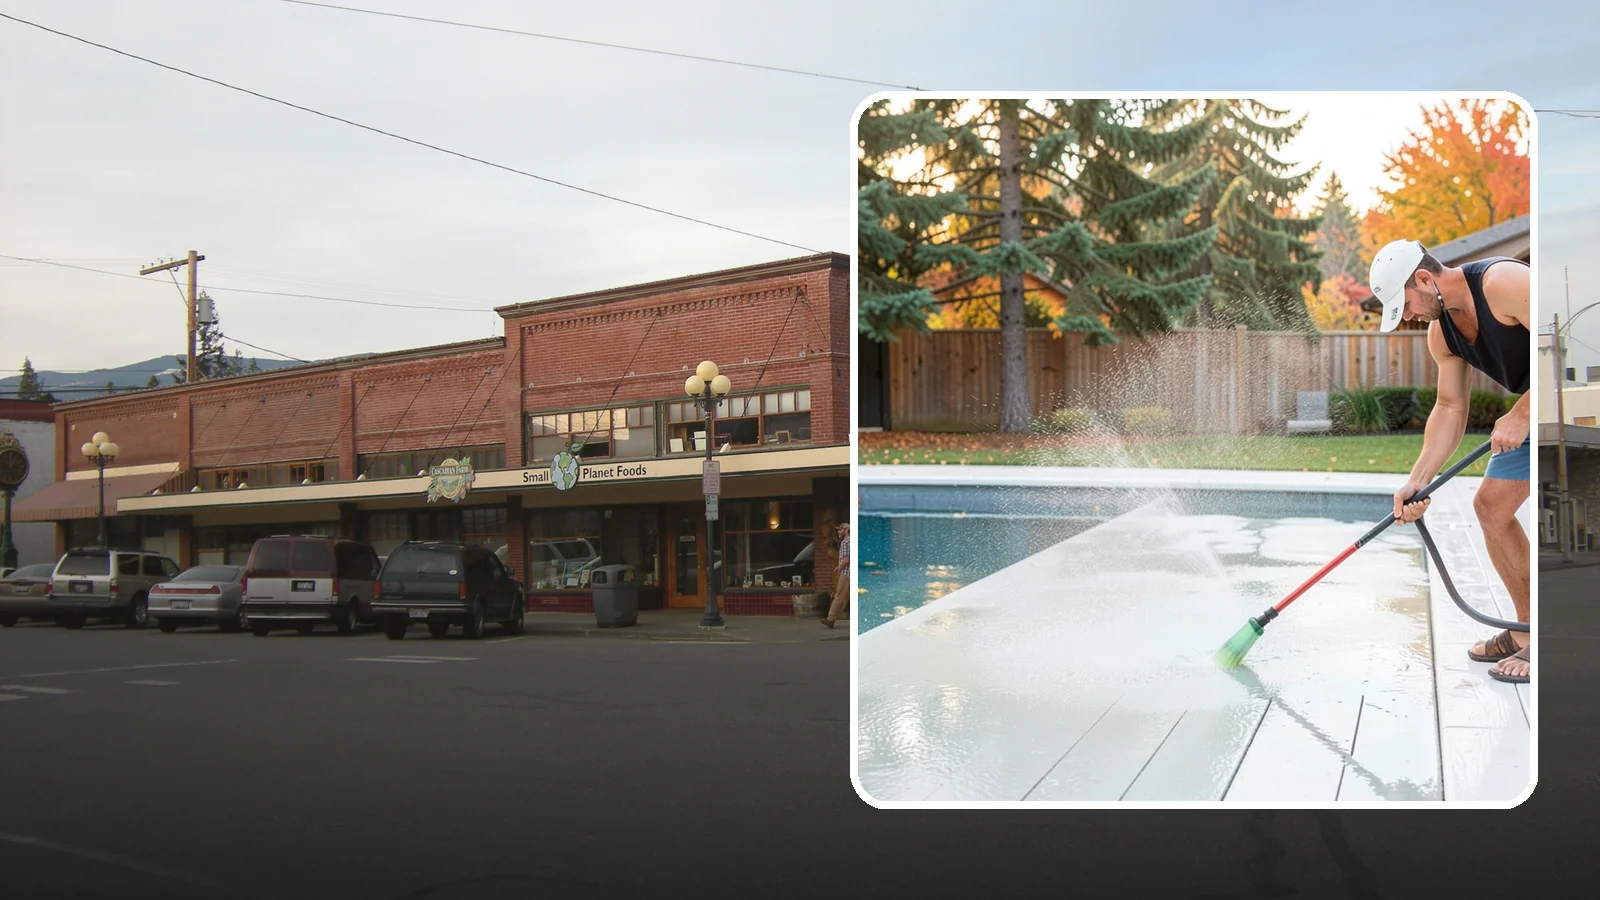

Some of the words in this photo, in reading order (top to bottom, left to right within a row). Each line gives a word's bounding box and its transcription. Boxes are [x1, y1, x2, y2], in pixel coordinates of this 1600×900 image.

[522, 470, 549, 483] Small
[582, 467, 614, 479] Planet
[616, 464, 647, 477] Foods
